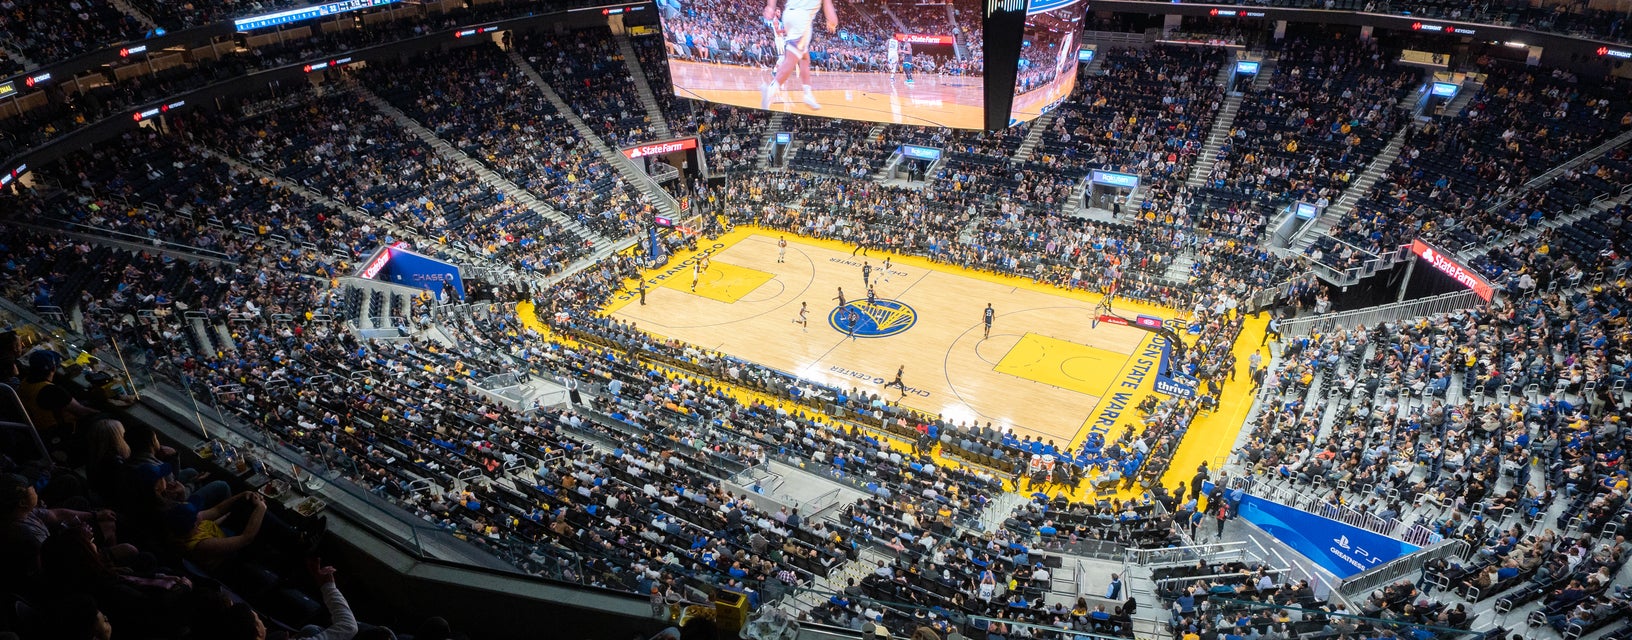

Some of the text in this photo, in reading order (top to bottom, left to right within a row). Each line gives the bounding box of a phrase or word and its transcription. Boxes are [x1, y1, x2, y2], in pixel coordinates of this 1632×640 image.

[412, 273, 443, 282] CHASE
[1121, 358, 1153, 390] STATE
[1330, 546, 1366, 571] GREATNESS
